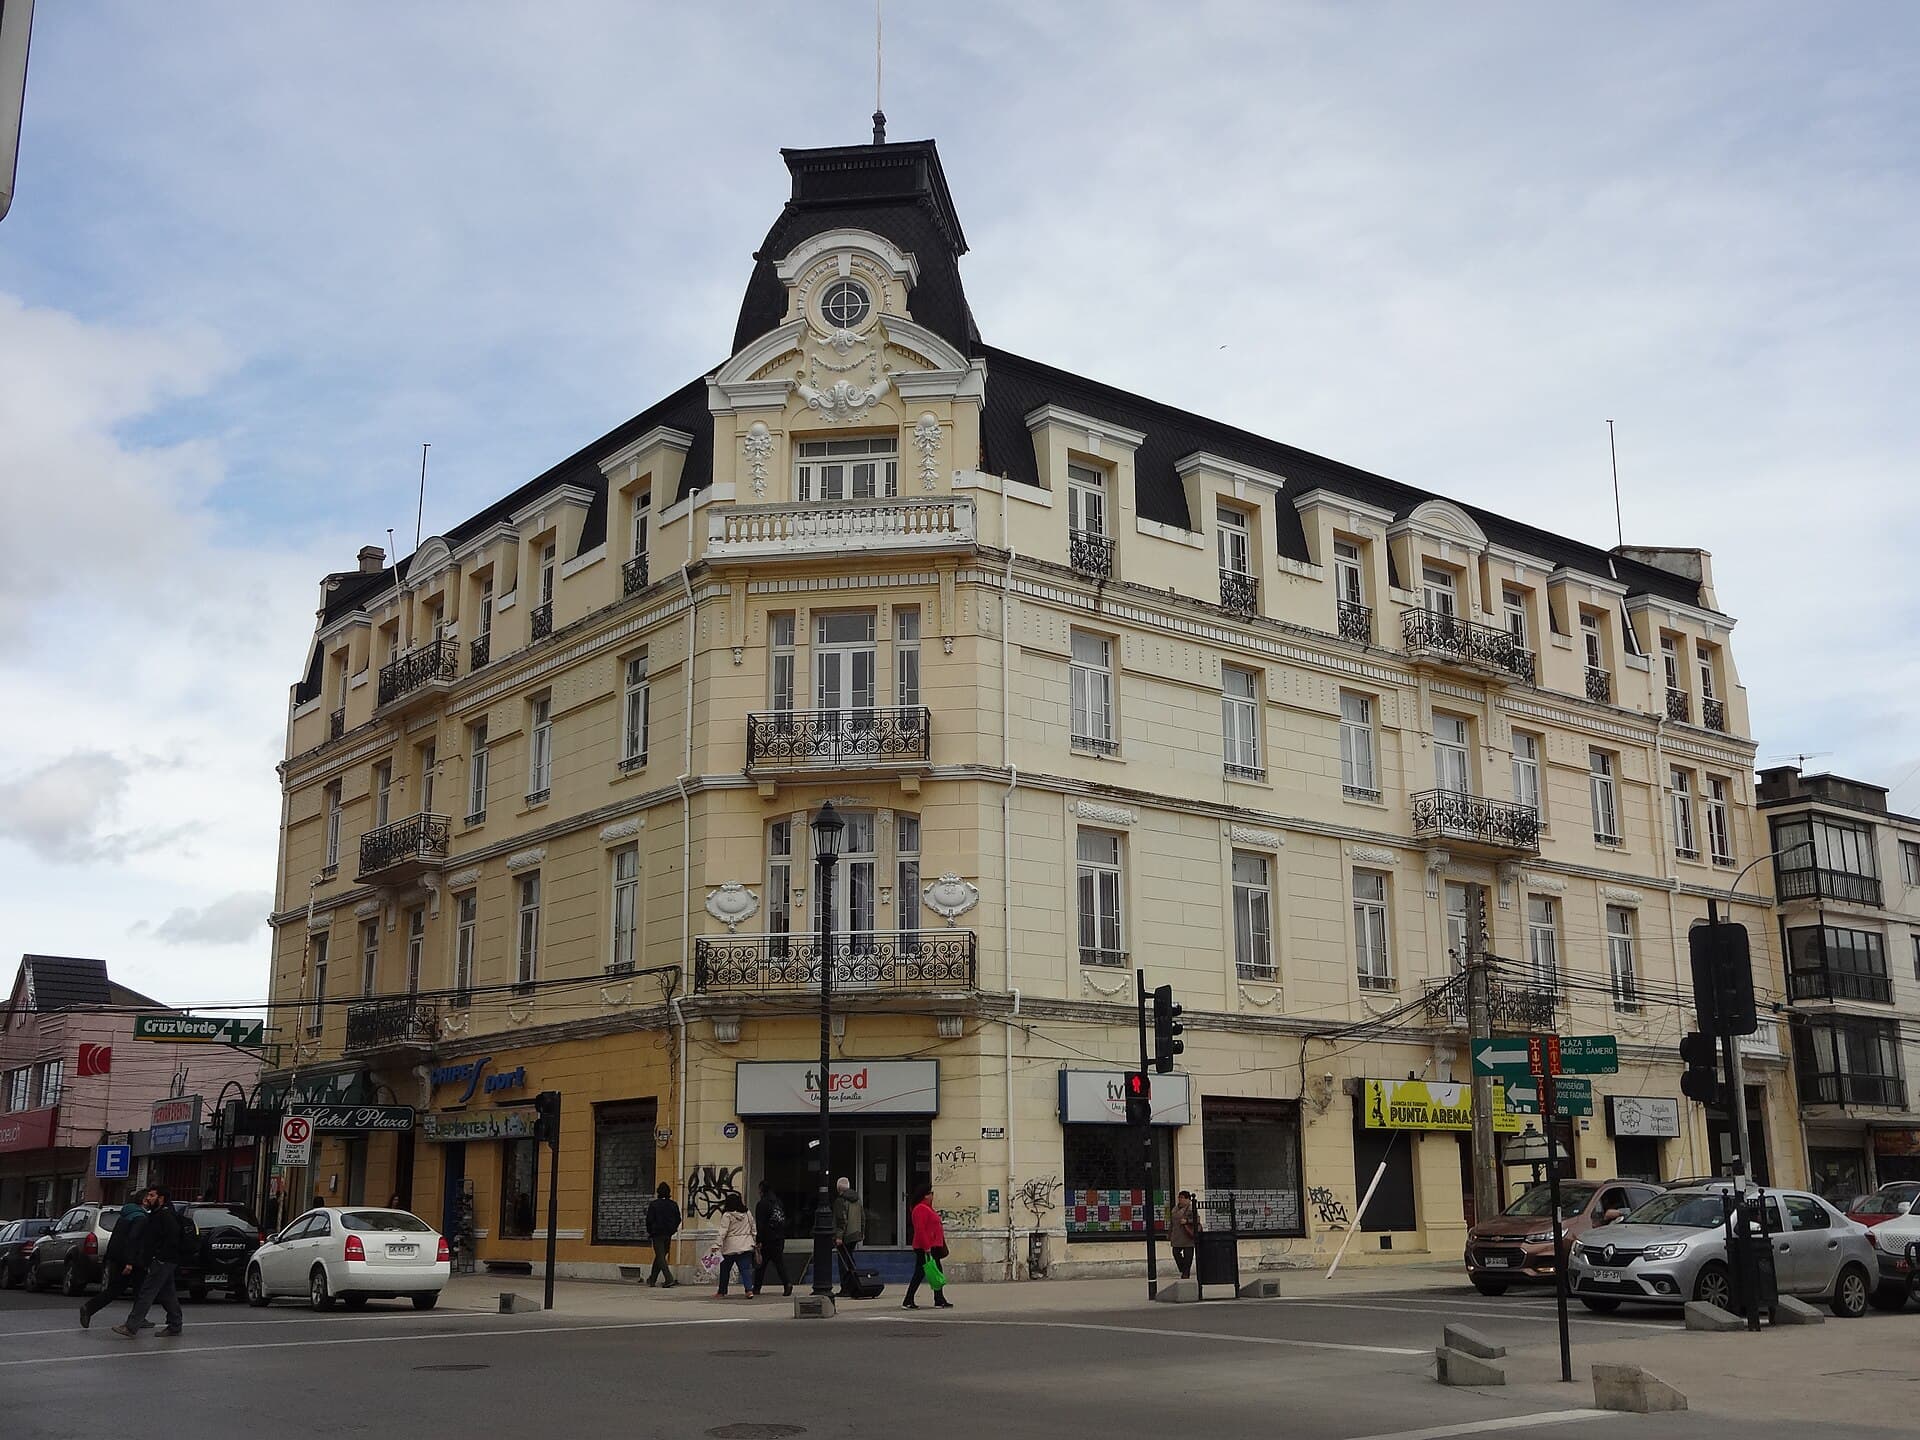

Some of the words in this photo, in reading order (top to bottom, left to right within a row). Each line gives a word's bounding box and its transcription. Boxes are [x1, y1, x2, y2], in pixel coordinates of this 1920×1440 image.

[1560, 1039, 1583, 1047] PLAZA
[1560, 1046, 1583, 1056] MUÑOZ
[1586, 1047, 1614, 1055] GAMERO
[302, 1107, 351, 1127] Hotel
[355, 1108, 408, 1128] Plaza
[1390, 1107, 1429, 1122] PUNTA
[106, 1150, 121, 1170] E
